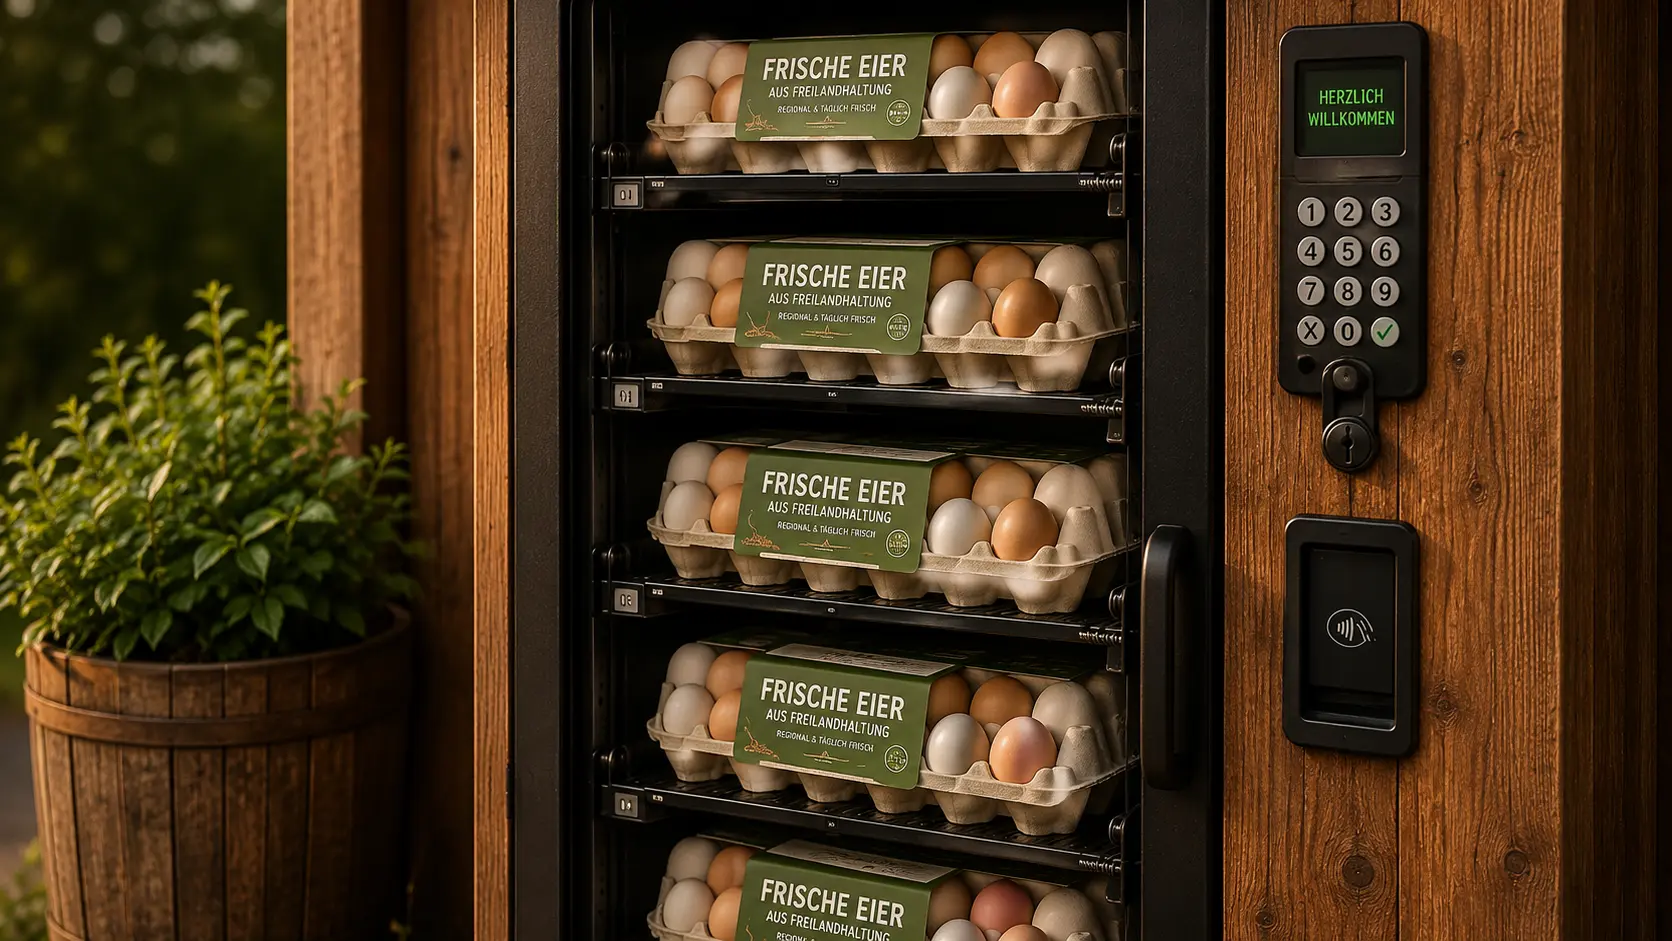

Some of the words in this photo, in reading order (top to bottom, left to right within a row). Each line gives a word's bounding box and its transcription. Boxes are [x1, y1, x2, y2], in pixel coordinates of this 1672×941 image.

[763, 56, 852, 80] FRISCHE
[858, 54, 907, 78] EIER
[768, 86, 789, 98] AUS
[792, 84, 892, 98] FREILANDHALTUNG
[1320, 88, 1384, 104] HERZLICH
[778, 105, 811, 114] REGIONAL
[814, 104, 819, 113] &
[850, 103, 876, 112] FRISCH
[1308, 110, 1395, 126] WILLKOMMEN
[1307, 203, 1314, 222] 1
[1342, 203, 1354, 221] 2
[1380, 203, 1392, 221] 3
[1304, 242, 1317, 260] 4
[1342, 242, 1354, 261] 5
[1380, 242, 1392, 261] 6
[762, 264, 852, 288] FRISCHE
[858, 266, 907, 290] EIER
[768, 293, 789, 304] AUS
[792, 294, 892, 308] FREILANDHALTUNG
[1305, 282, 1316, 300] 7
[1342, 282, 1354, 300] 8
[1379, 282, 1392, 301] 9
[778, 312, 812, 322] REGIONAL
[814, 314, 819, 322] &
[850, 314, 876, 324] FRISCH
[1304, 322, 1318, 340] X
[1342, 322, 1354, 340] 0
[762, 470, 852, 500] FRISCHE
[858, 479, 906, 506] EIER
[768, 500, 788, 514] AUS
[792, 502, 892, 524] FREILANDHALTUNG
[777, 521, 810, 532] REGIONAL
[812, 524, 818, 533] &
[850, 528, 876, 538] FRISCH
[760, 678, 850, 713] FRISCHE
[856, 692, 905, 720] EIER
[766, 708, 787, 722] AUS
[790, 712, 890, 738] FREILANDHALTUNG
[776, 730, 810, 742] REGIONAL
[812, 736, 817, 744] &
[849, 741, 874, 752] FRISCH
[760, 878, 850, 918] FRISCHE
[856, 896, 905, 928] EIER
[766, 910, 788, 924] AUS
[790, 914, 890, 941] FREILANDHALTUNG
